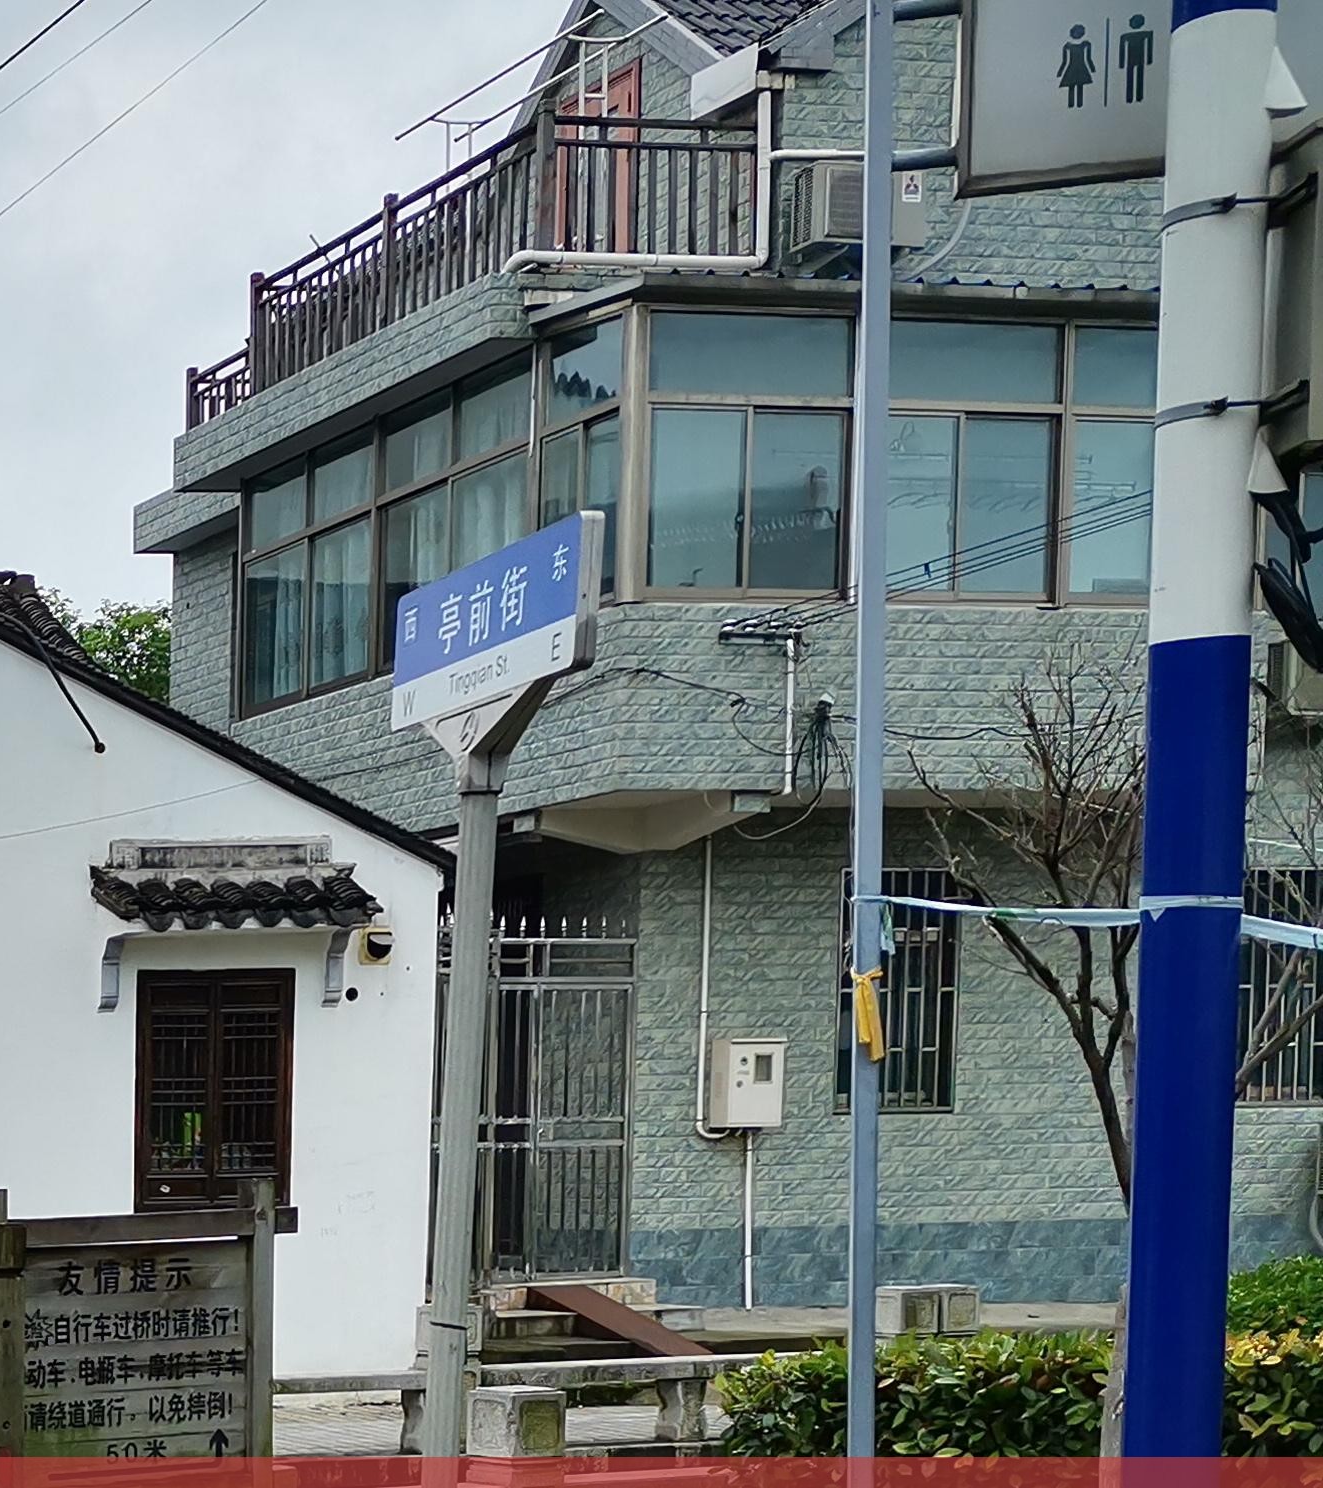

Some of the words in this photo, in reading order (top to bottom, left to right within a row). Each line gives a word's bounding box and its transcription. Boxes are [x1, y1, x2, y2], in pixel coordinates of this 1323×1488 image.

[438, 565, 528, 655] 亭前街
[551, 543, 569, 582] 东
[402, 690, 416, 716] W
[449, 664, 493, 696] Tingqian
[551, 632, 562, 662] E
[58, 1257, 193, 1297] 友情提示
[106, 1439, 168, 1466] 50米
